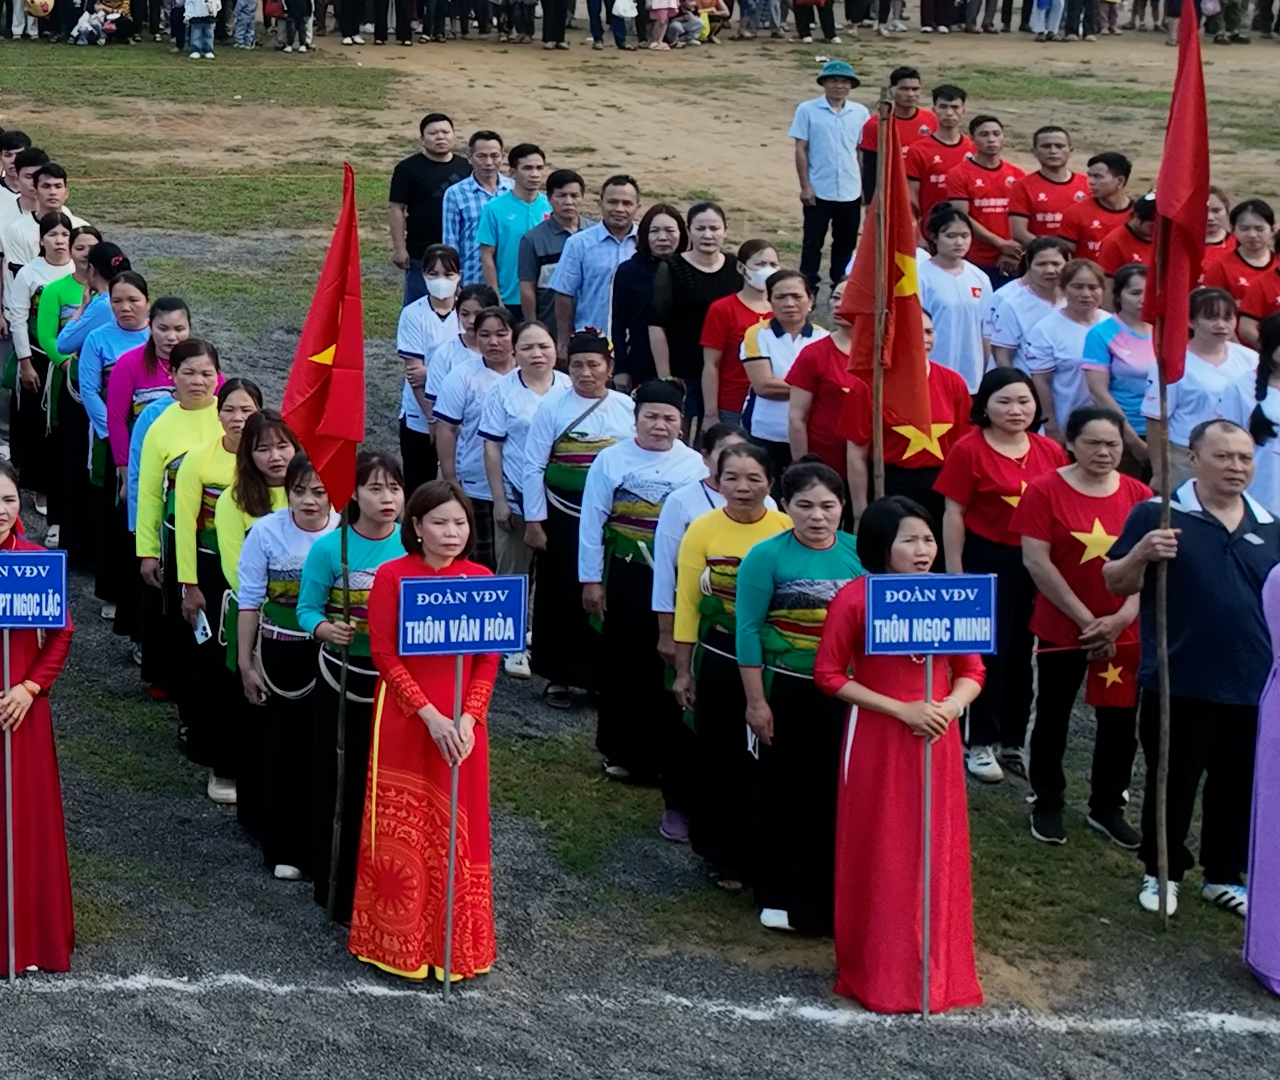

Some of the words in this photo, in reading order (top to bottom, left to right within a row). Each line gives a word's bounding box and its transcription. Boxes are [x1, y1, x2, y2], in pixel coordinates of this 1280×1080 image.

[12, 565, 50, 578] VĐV
[13, 593, 40, 621] NGỌC
[41, 589, 60, 621] LẶC
[416, 589, 468, 605] ĐOÀN
[471, 590, 509, 603] VĐV
[885, 586, 936, 603] ĐOÀN
[940, 588, 979, 601] VĐV
[405, 615, 445, 644] THÔN
[449, 614, 480, 642] VÂN
[484, 612, 515, 641] HÒA
[874, 613, 910, 643] THÔN
[912, 617, 951, 647] NGỌC
[954, 617, 991, 642] MINH
